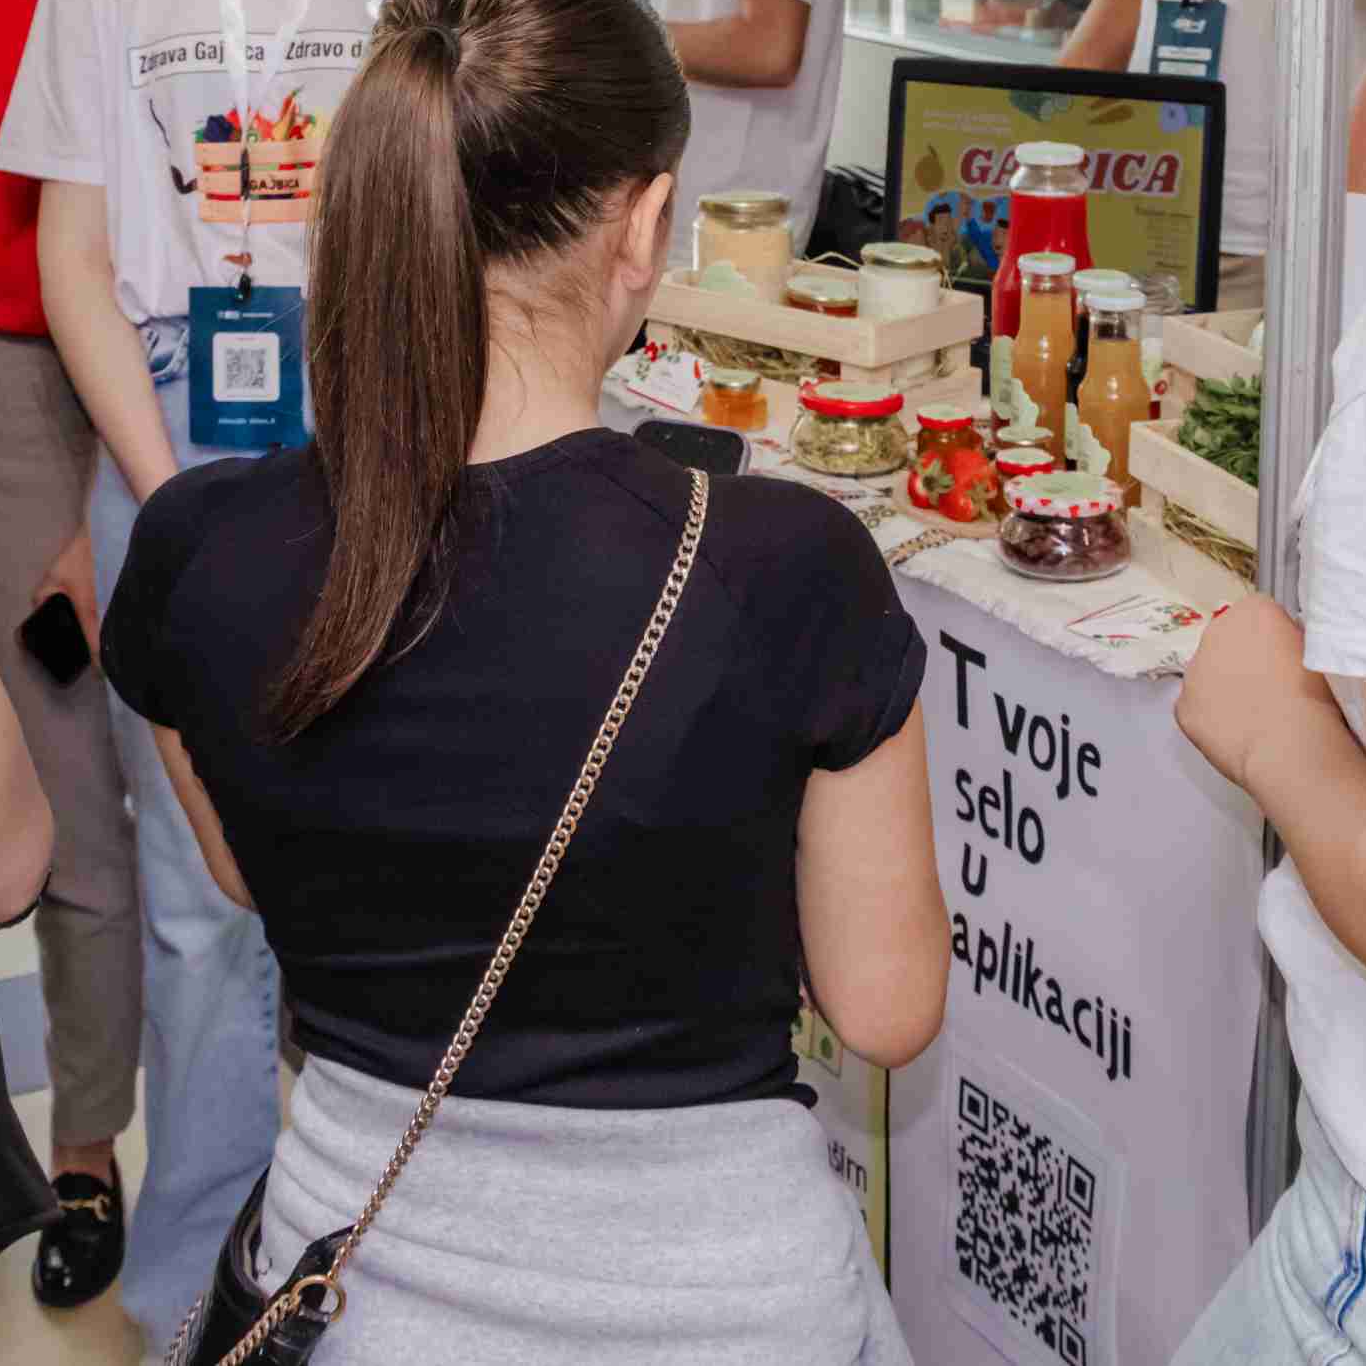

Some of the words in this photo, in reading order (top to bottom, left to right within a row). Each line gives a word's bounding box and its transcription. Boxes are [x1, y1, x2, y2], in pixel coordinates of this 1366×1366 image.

[138, 46, 187, 75] Zdrava
[194, 40, 265, 64] Gajca
[960, 147, 1181, 193] GAICA
[955, 767, 1046, 866] selo
[961, 842, 988, 897] u
[951, 912, 1132, 1082] aplikaciji
